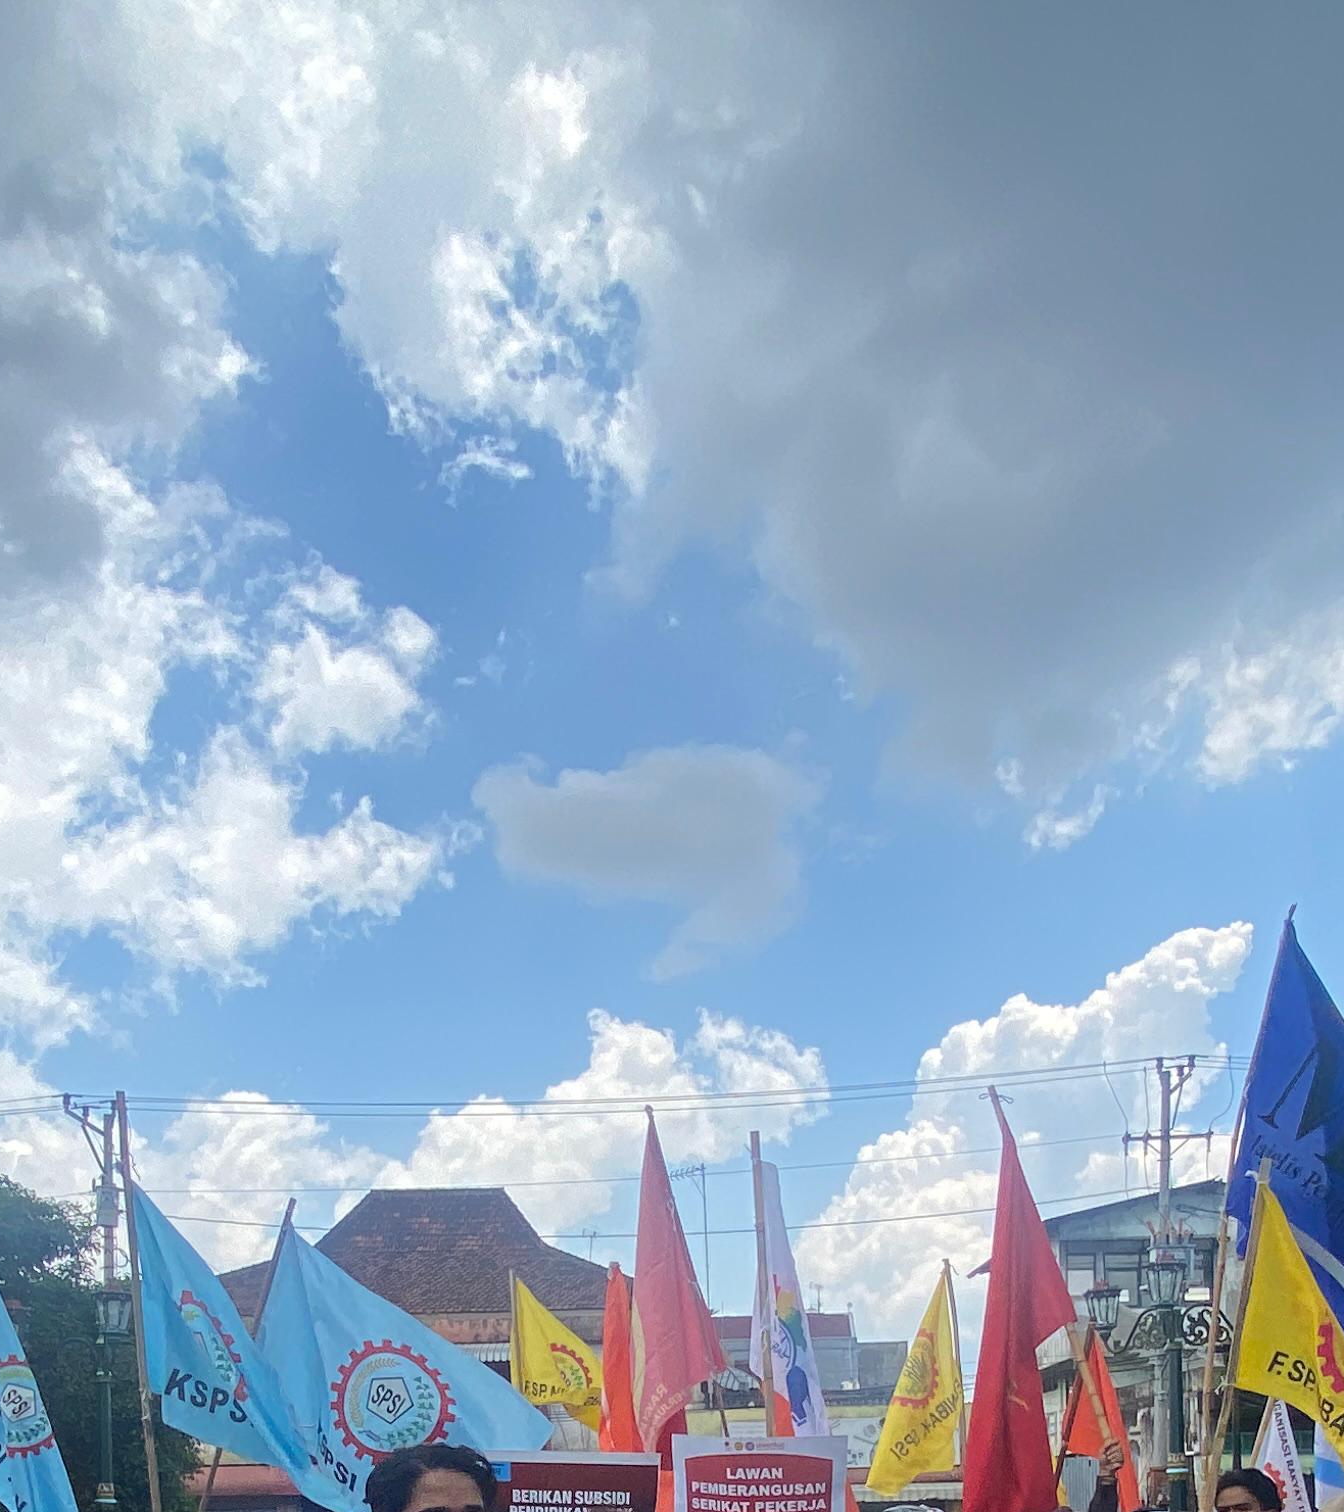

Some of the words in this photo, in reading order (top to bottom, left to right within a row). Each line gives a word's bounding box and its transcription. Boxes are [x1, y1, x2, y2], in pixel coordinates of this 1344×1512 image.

[2, 1389, 31, 1419] SPSI
[371, 1382, 406, 1418] SPSI
[726, 1467, 783, 1480] LAWAN
[691, 1481, 827, 1496] PEMBERANGUSAN
[511, 1489, 573, 1504] BERIKAN
[575, 1490, 631, 1505] SUBSIDI
